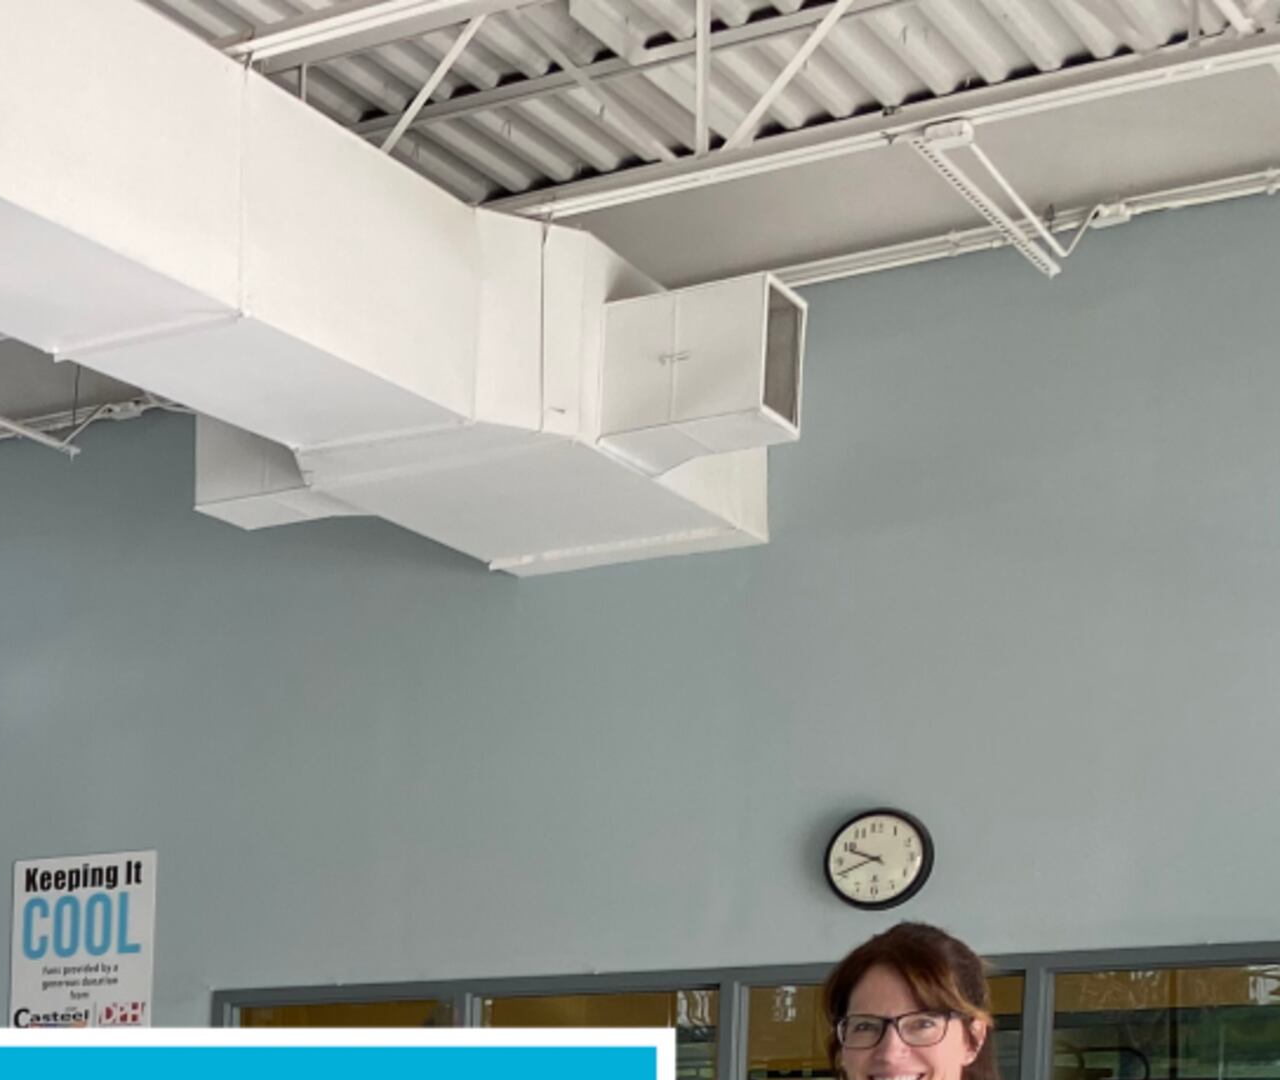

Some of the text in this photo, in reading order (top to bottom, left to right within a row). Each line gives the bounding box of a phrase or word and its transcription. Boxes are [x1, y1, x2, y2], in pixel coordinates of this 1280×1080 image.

[25, 860, 143, 893] Keeping It
[23, 891, 142, 961] COOL
[63, 963, 99, 977] provided
[101, 962, 111, 975] by
[82, 976, 118, 987] donation
[69, 990, 90, 1000] from
[14, 1007, 89, 1028] Casteel
